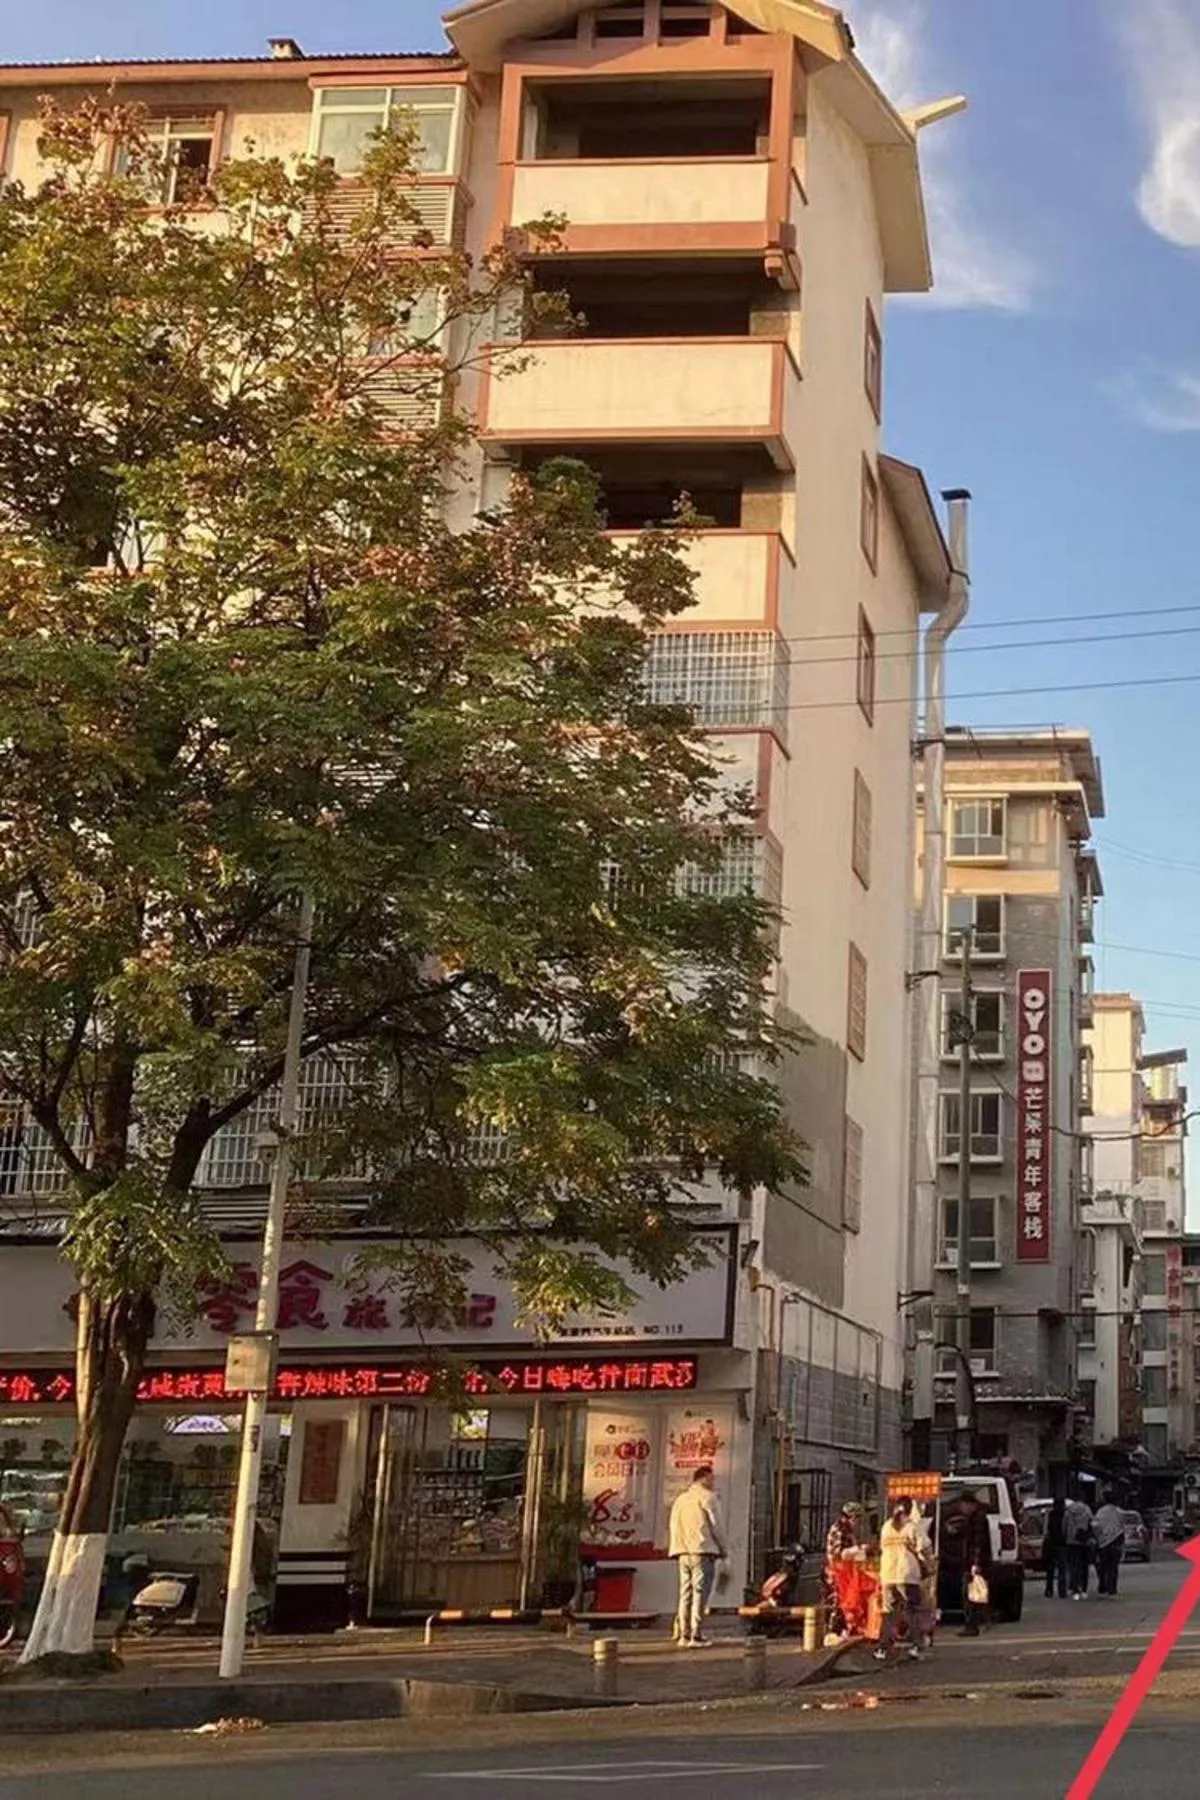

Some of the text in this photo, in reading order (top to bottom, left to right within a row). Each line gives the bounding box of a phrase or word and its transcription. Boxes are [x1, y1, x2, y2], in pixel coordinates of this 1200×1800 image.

[1022, 988, 1046, 1056] OYO
[1022, 1087, 1044, 1240] 芒果青年客栈
